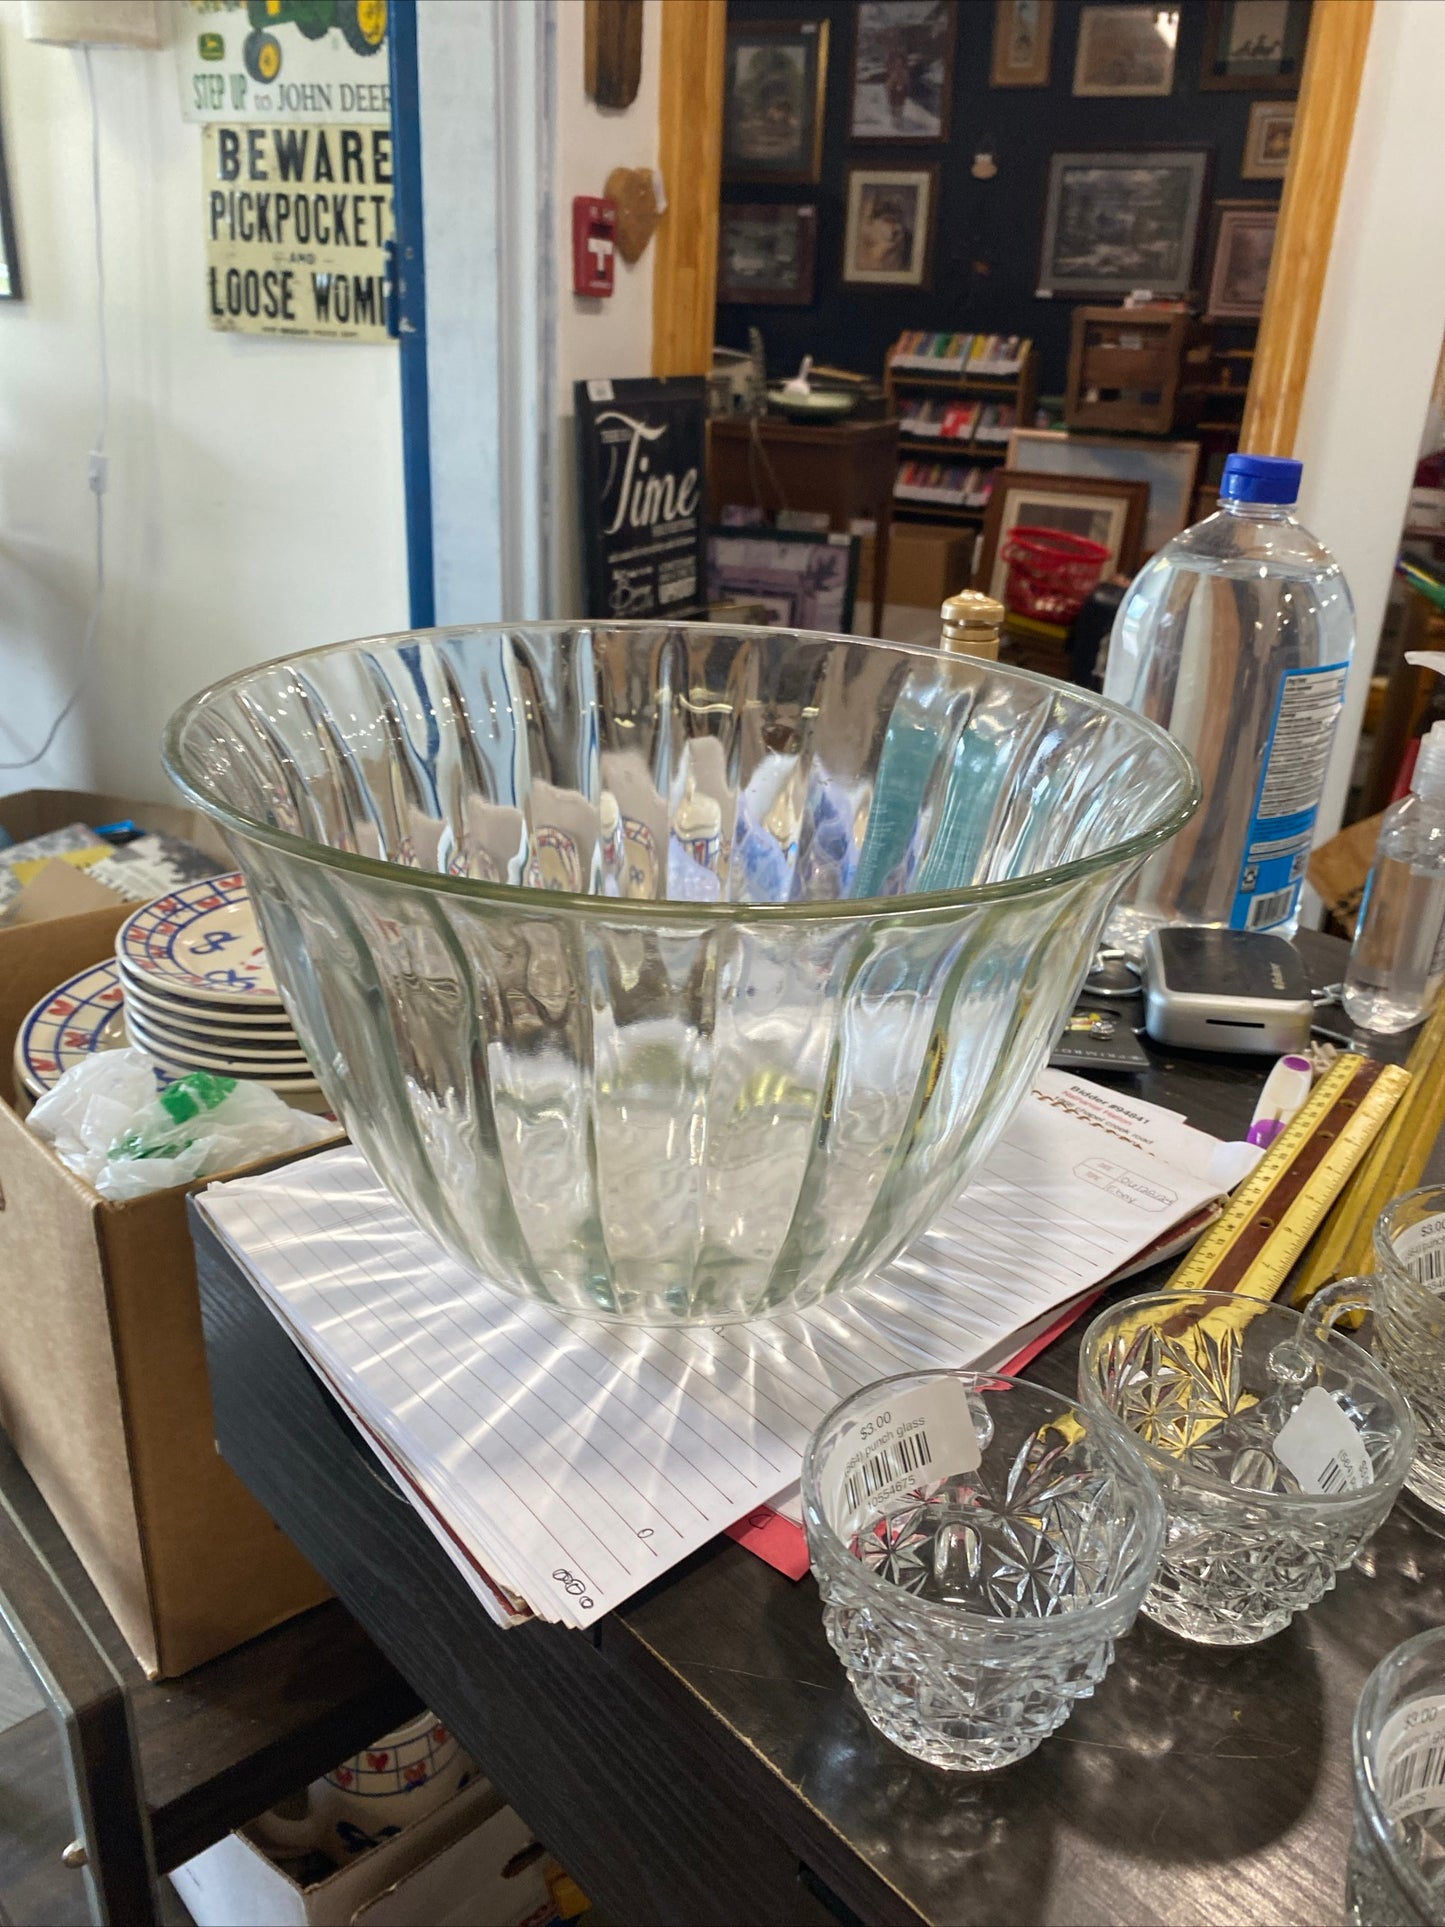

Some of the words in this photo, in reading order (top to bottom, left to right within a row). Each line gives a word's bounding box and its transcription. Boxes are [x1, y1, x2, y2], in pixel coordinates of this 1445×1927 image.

[193, 73, 225, 110] STEP
[229, 73, 247, 110] UP
[254, 93, 273, 111] to
[277, 83, 332, 112] JOHN
[218, 128, 392, 184] BEWARE
[210, 190, 388, 248] PICKPOCKET
[288, 253, 316, 264] AND
[209, 266, 295, 320] LOOSE
[594, 410, 698, 535] Time
[1070, 1085, 1110, 1105] Bidder
[859, 1411, 892, 1440] $3.00
[865, 1431, 895, 1458] punch
[896, 1416, 926, 1438] glass
